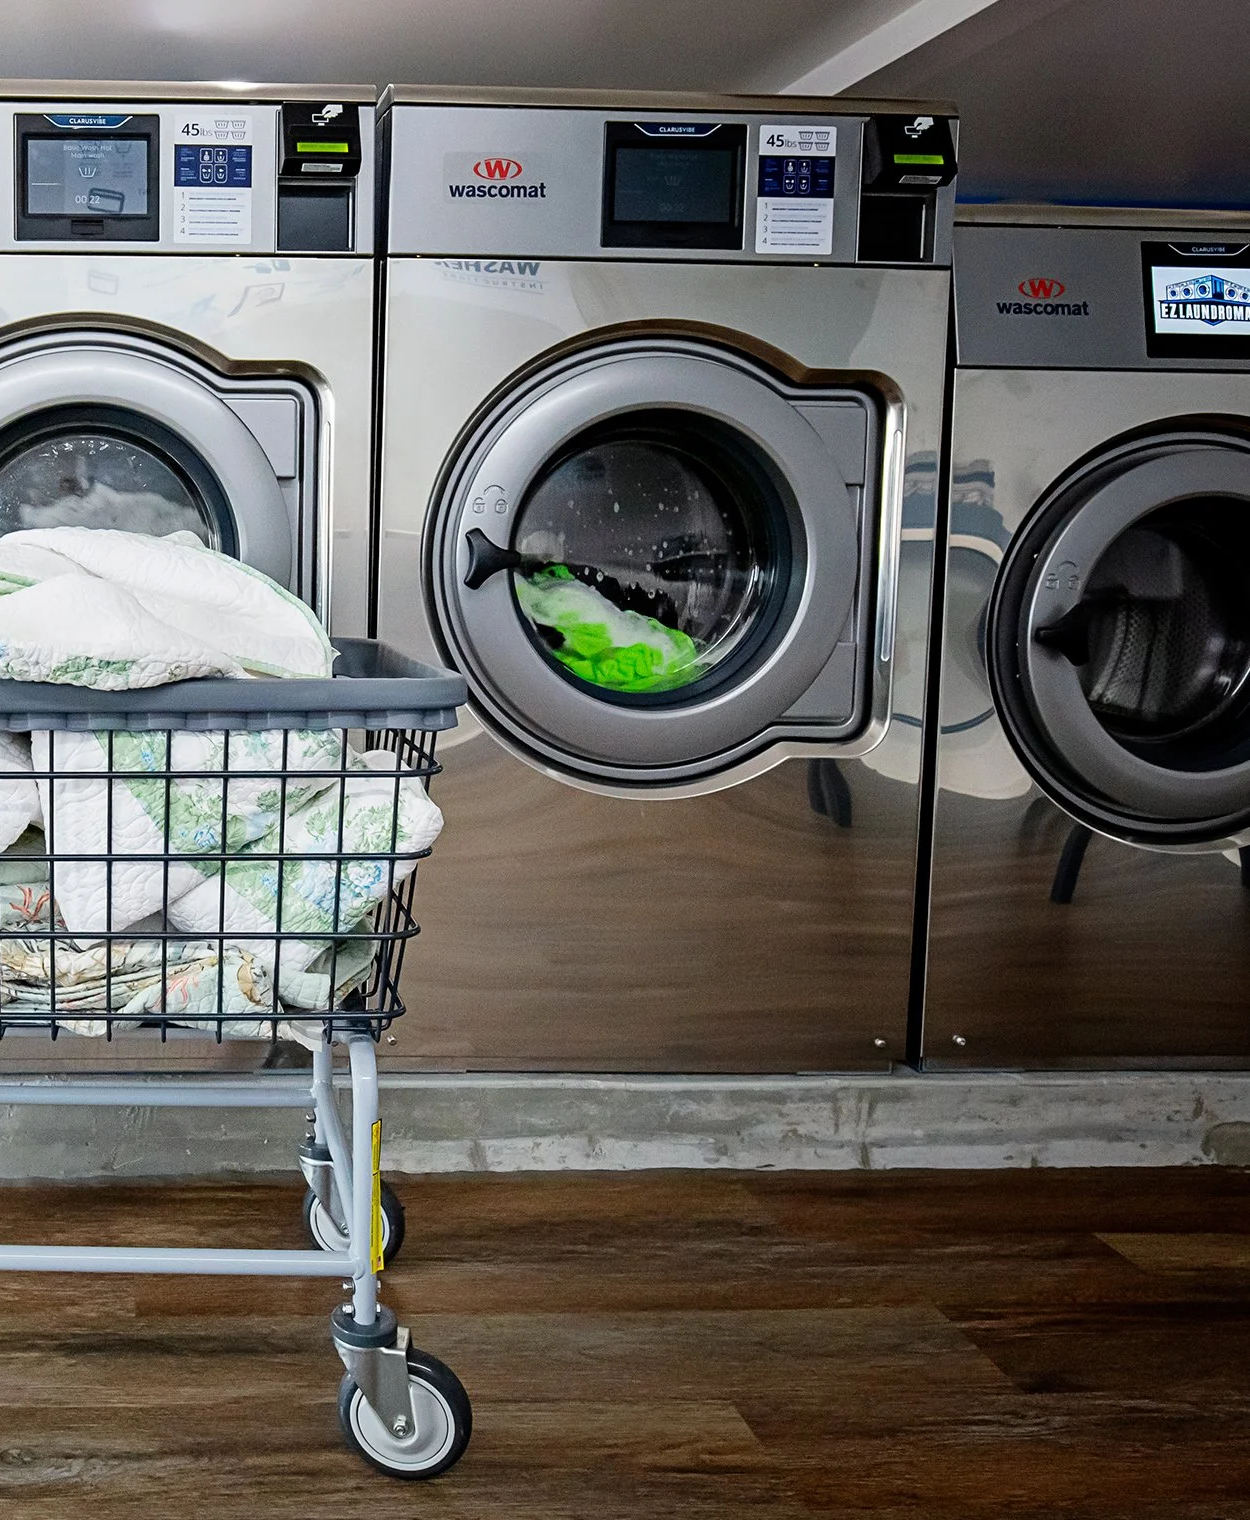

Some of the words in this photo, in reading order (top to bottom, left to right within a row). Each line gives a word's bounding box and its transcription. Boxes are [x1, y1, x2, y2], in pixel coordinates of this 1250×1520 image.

[449, 182, 546, 198] wascomat
[996, 301, 1089, 316] wascomat
[1161, 303, 1178, 318] EZ
[1179, 304, 1250, 321] LAUNDROMA
